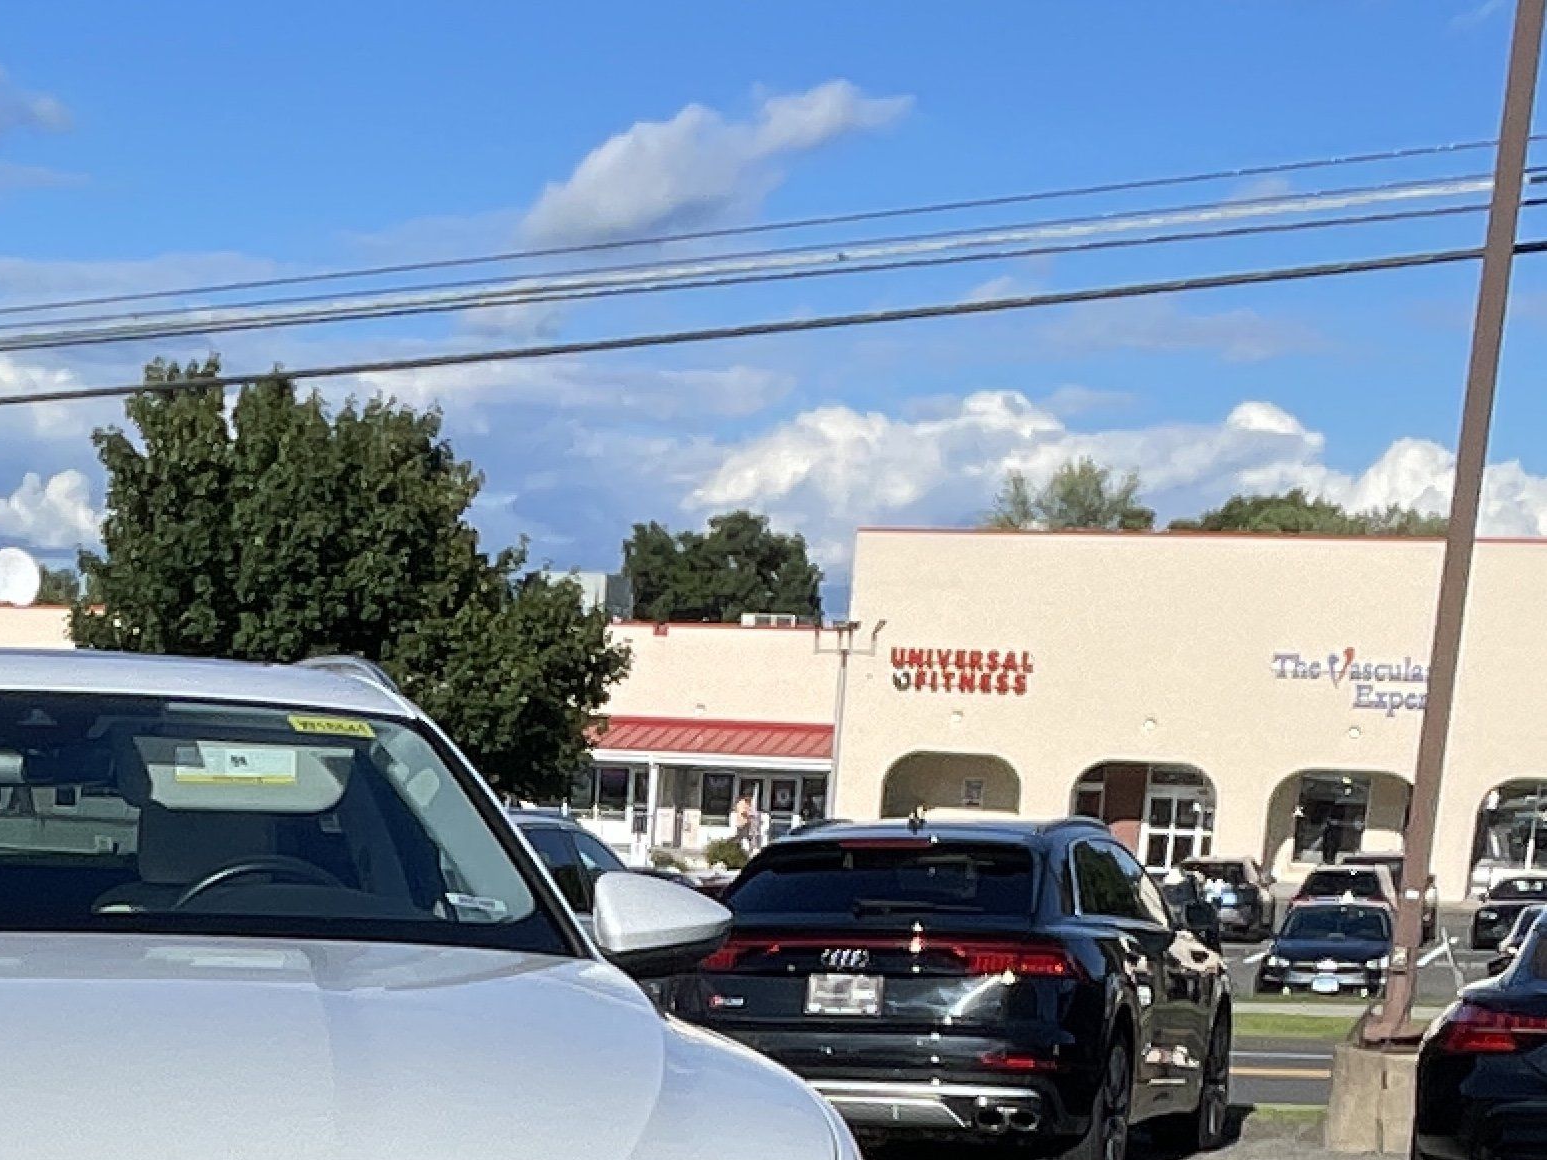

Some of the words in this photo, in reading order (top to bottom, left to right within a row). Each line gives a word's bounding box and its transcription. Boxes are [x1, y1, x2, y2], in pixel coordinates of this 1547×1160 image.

[891, 647, 1033, 673] UNIVERSAL
[1272, 653, 1321, 679] The
[1327, 647, 1430, 689] Vascula
[915, 670, 1027, 695] FITNESS
[1353, 684, 1428, 717] Exper
